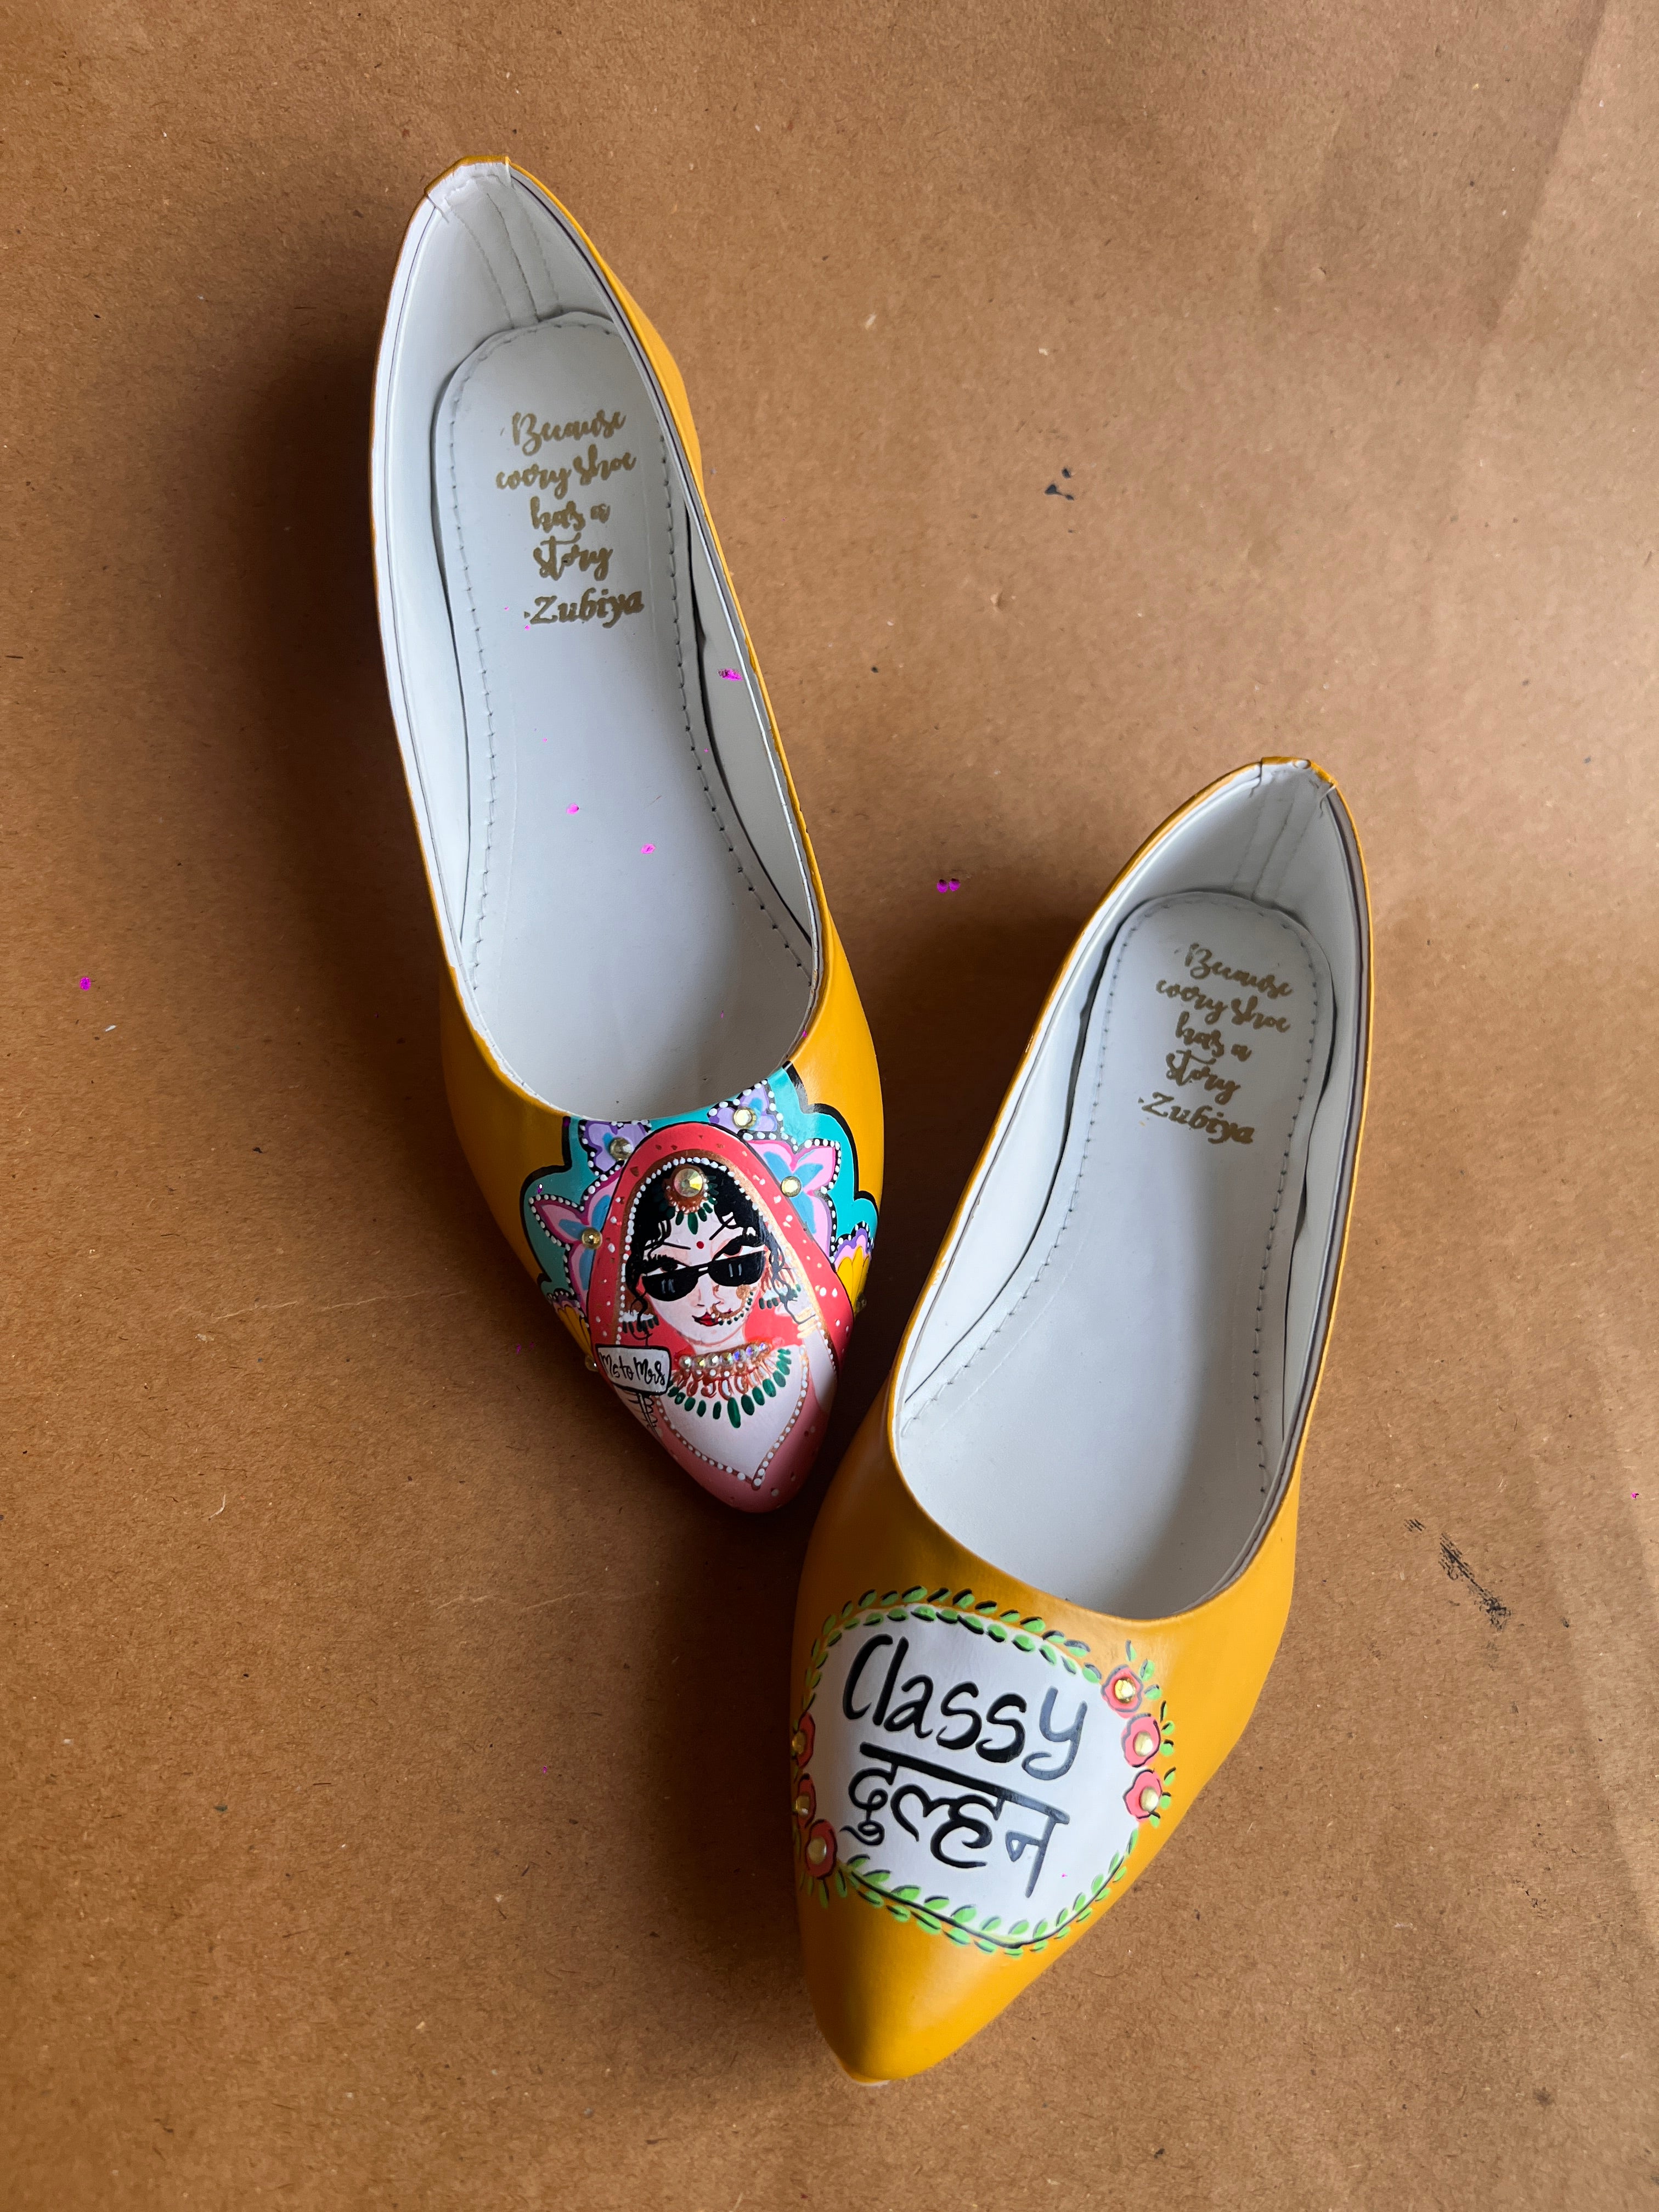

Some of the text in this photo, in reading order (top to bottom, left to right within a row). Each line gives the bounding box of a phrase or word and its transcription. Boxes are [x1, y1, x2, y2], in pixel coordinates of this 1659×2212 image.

[512, 409, 626, 456] Because
[530, 496, 611, 533] has a
[530, 588, 644, 629] Zubiya
[1184, 943, 1293, 999] Because
[1176, 1011, 1252, 1062] has a
[1142, 1092, 1255, 1144] Zubiya
[619, 1356, 634, 1380] to
[843, 1634, 1088, 1780] Classy
[840, 1742, 1070, 1898] दुल्हन
